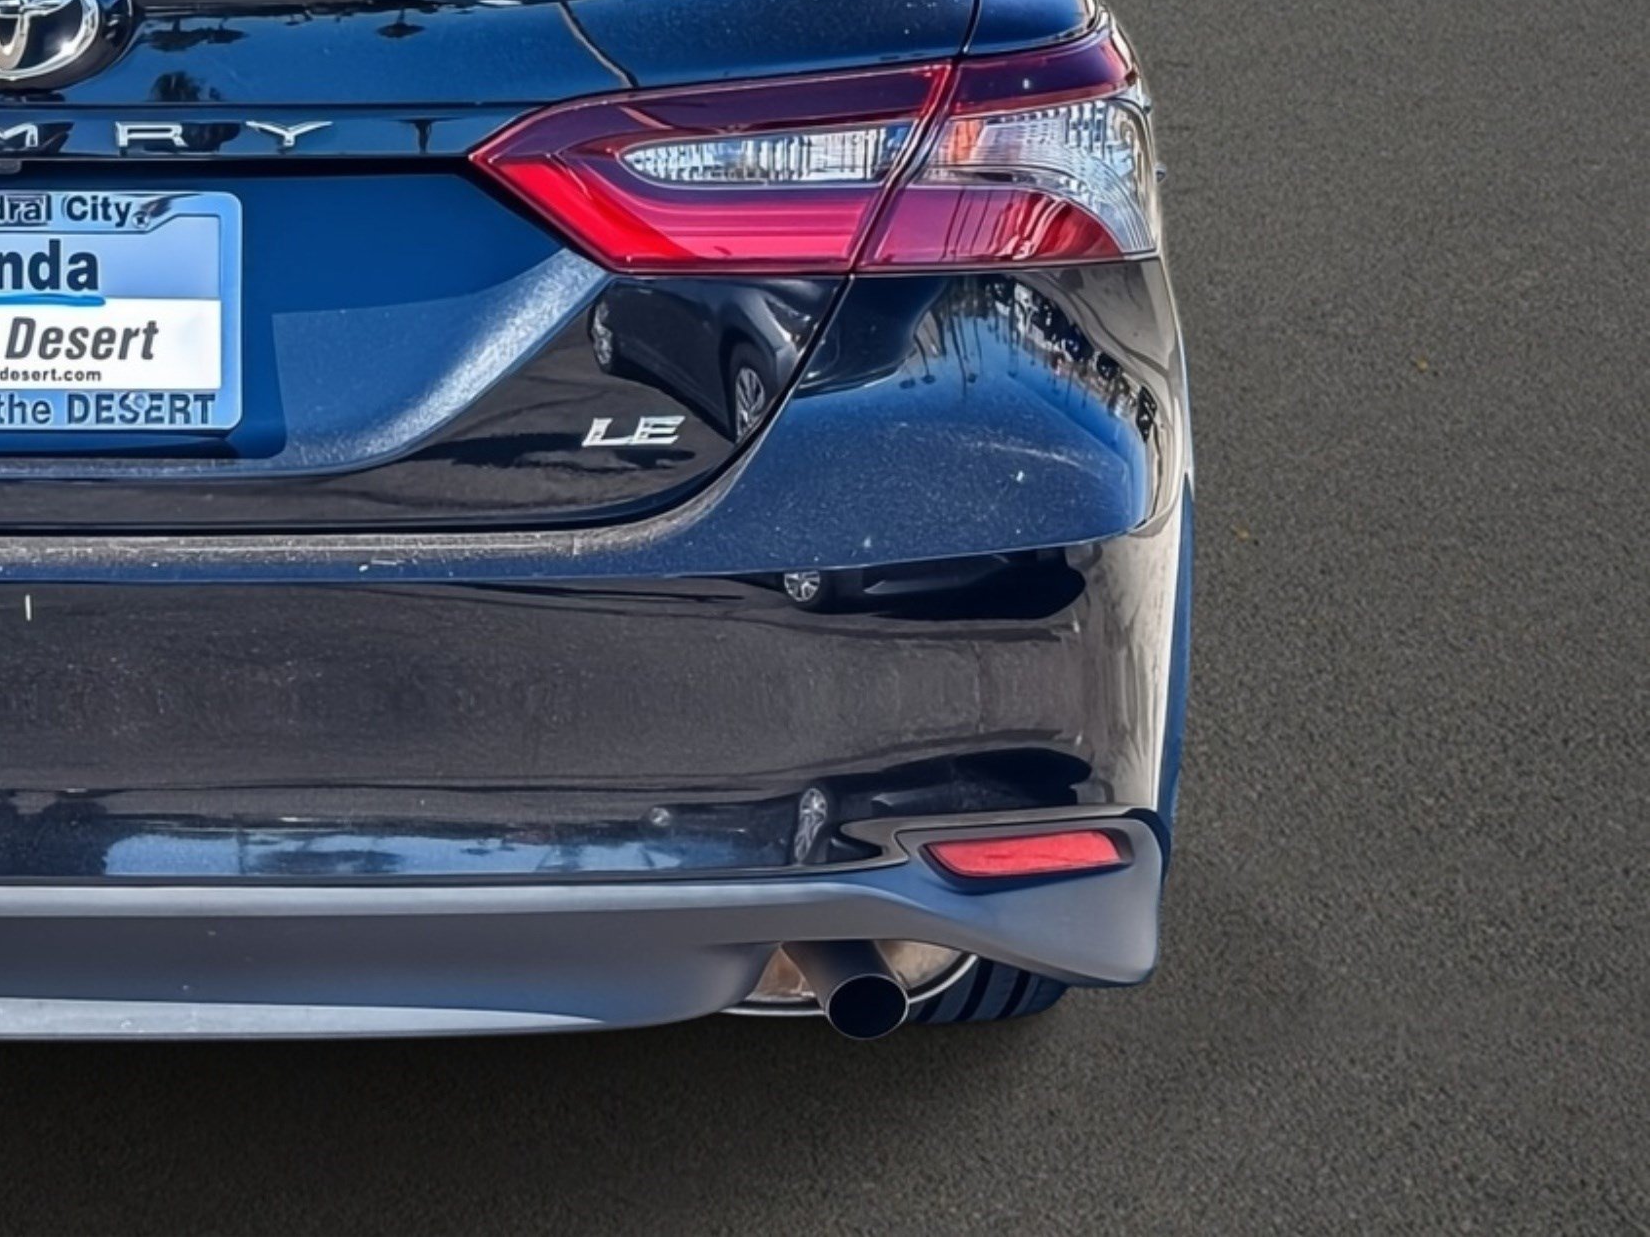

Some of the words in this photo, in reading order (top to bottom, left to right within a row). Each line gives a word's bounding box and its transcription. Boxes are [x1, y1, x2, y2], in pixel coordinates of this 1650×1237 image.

[65, 195, 133, 227] City
[5, 317, 160, 361] Desert
[66, 393, 216, 426] DESERT
[581, 415, 686, 448] LE
